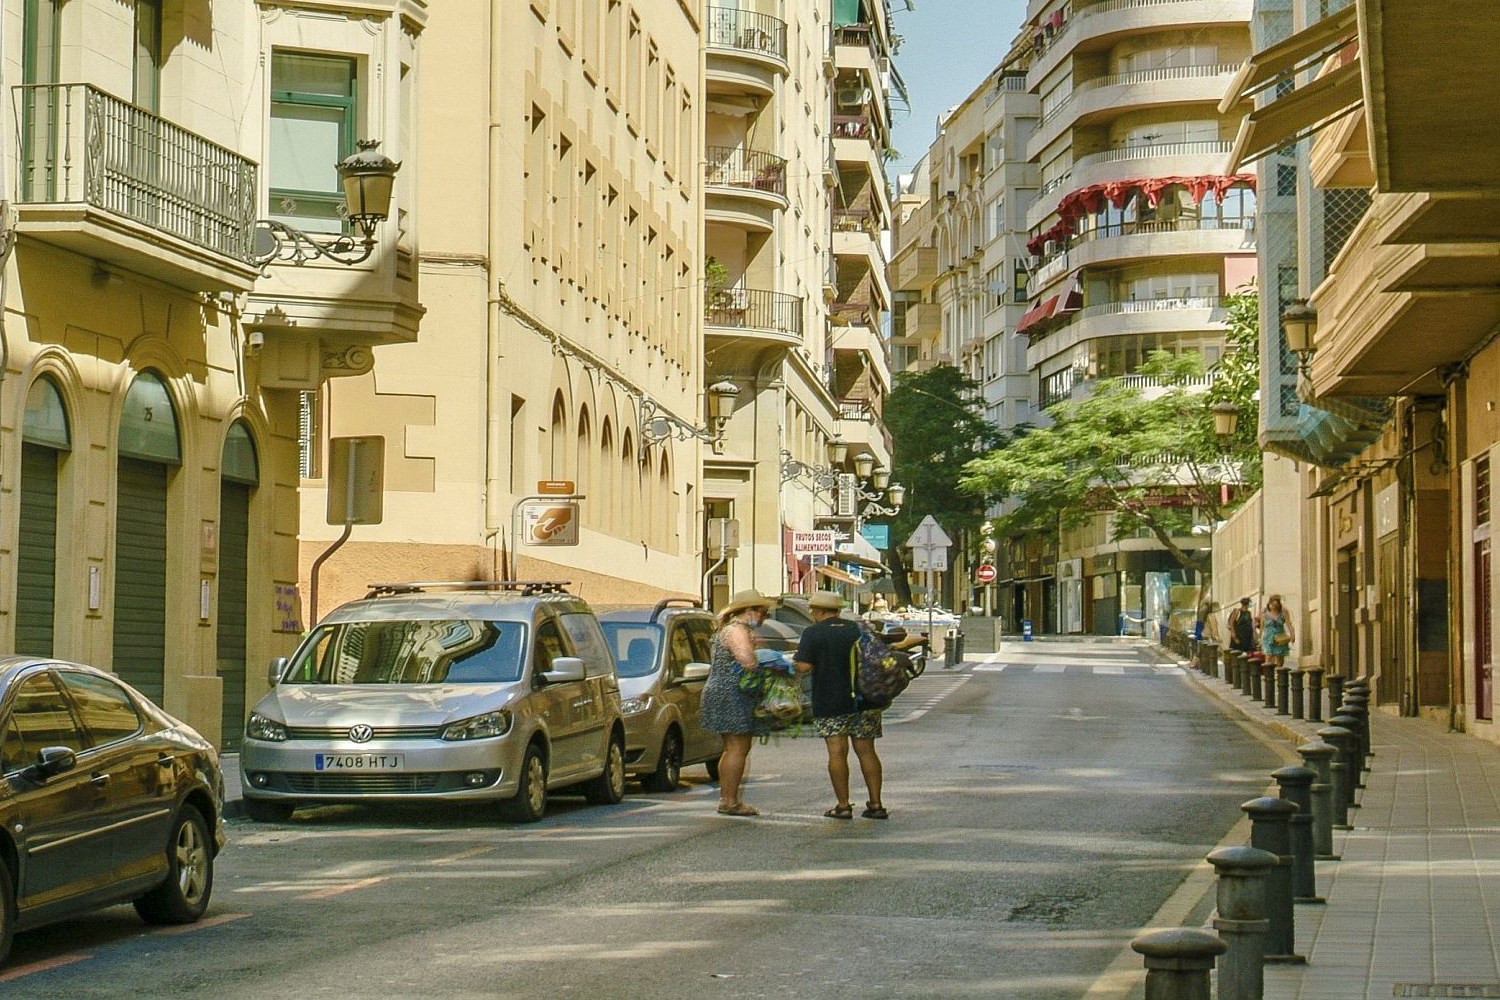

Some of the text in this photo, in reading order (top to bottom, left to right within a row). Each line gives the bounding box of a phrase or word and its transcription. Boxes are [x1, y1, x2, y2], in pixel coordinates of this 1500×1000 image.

[795, 533, 815, 541] FRUTOS
[326, 756, 398, 768] 7408 HTJ
